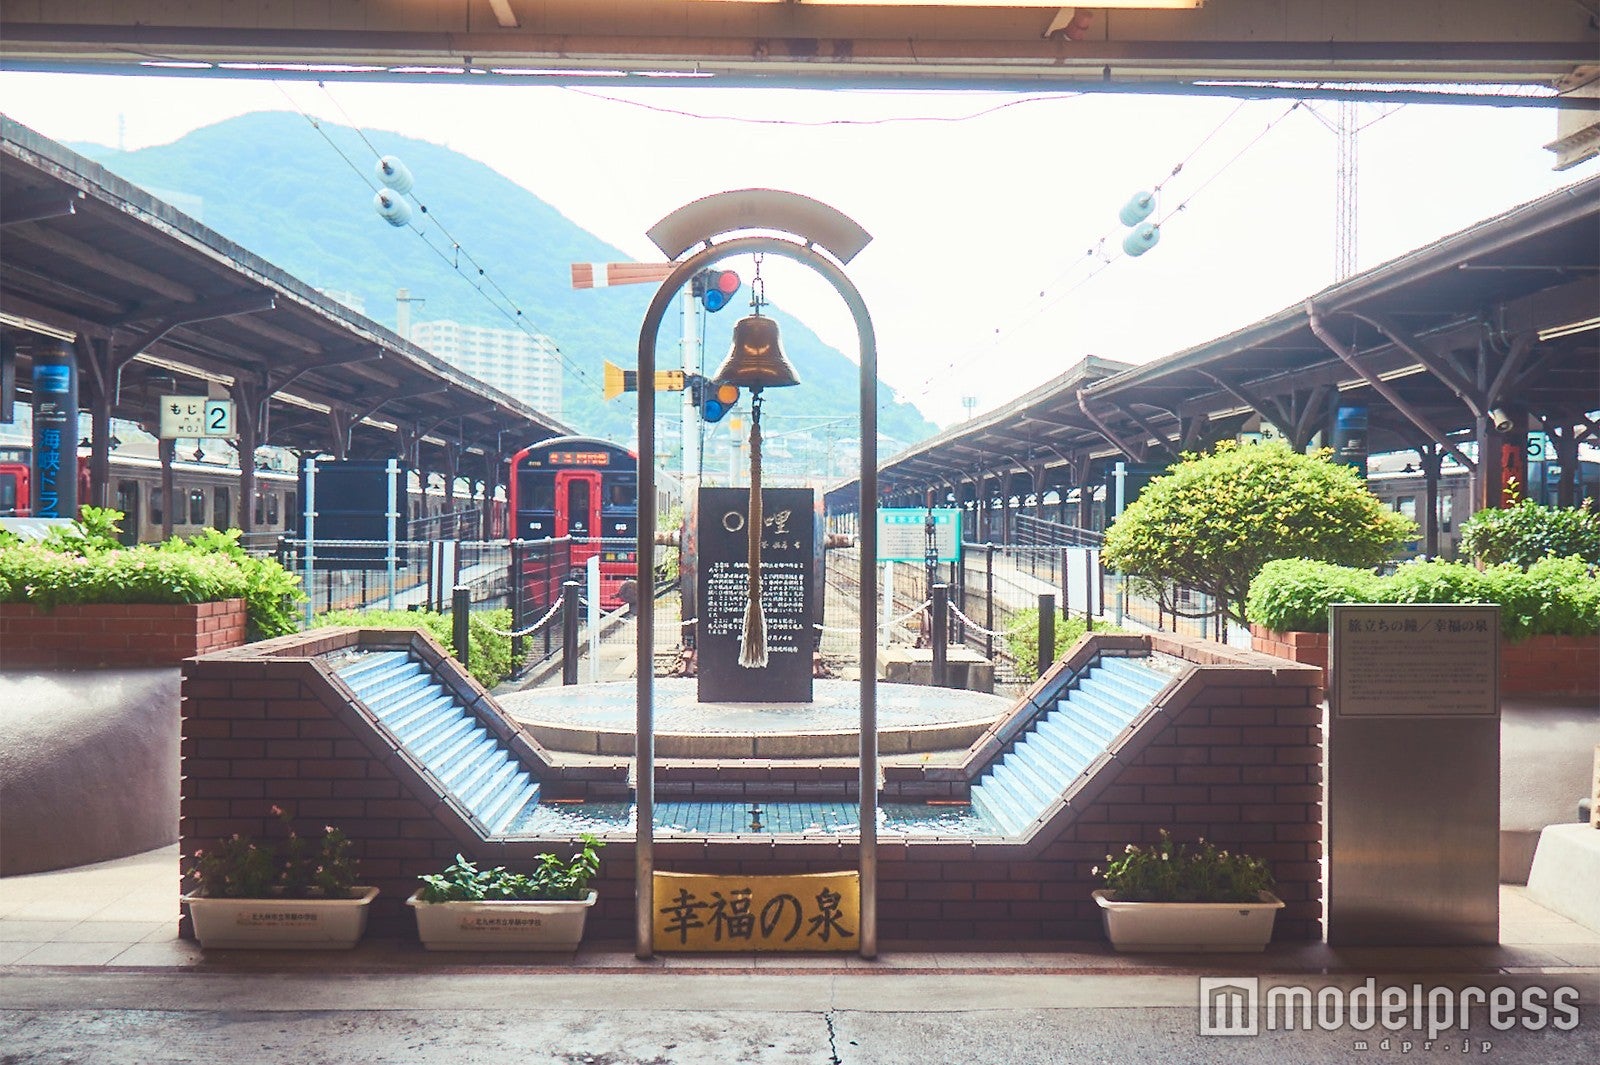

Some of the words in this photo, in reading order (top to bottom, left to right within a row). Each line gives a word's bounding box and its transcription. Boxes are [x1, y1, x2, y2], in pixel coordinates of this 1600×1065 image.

[170, 403, 205, 415] もじ
[210, 407, 226, 429] 2
[1527, 437, 1541, 456] 5
[659, 886, 855, 945] 幸福の泉
